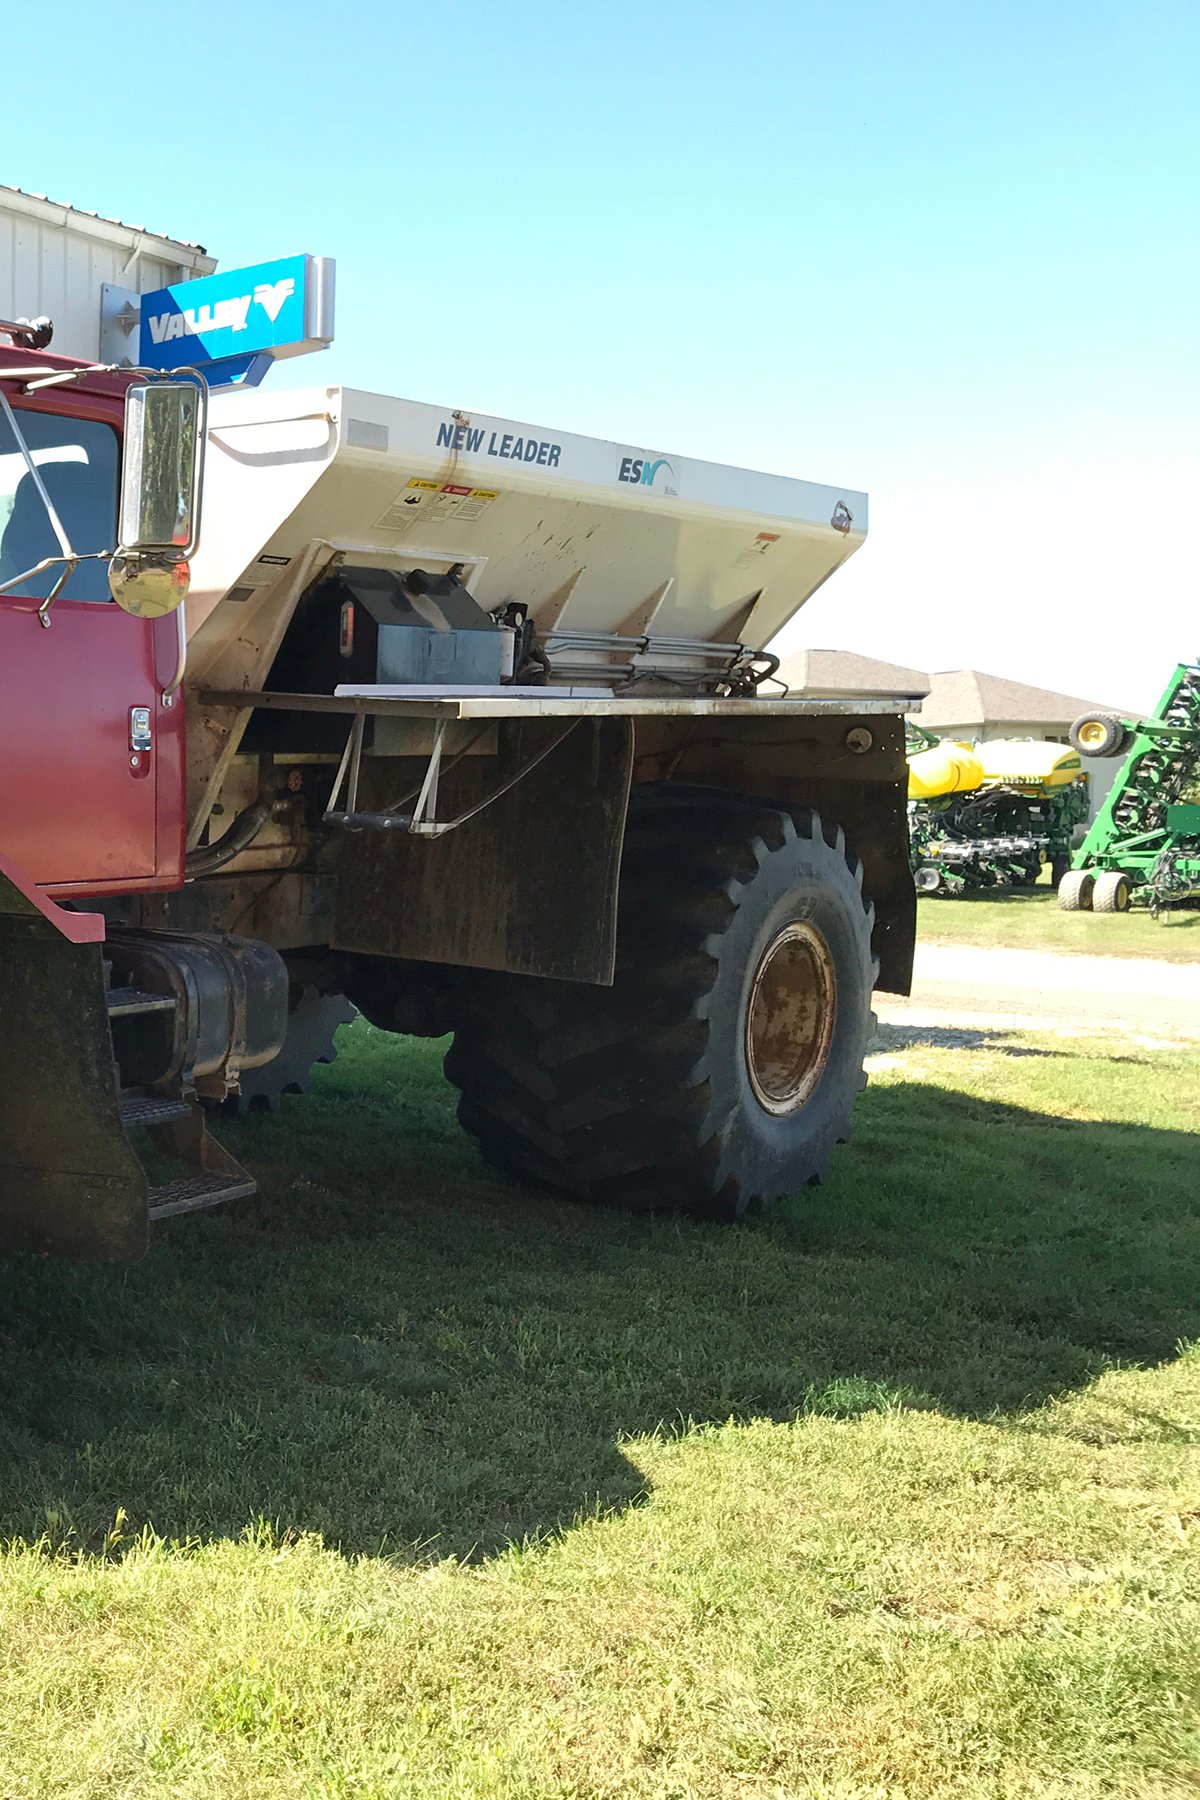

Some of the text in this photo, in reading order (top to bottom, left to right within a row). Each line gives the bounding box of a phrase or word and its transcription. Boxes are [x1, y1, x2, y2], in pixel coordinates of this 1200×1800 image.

[148, 294, 253, 345] VALLEY
[436, 422, 562, 468] NEW LEADER
[618, 457, 675, 486] ESN
